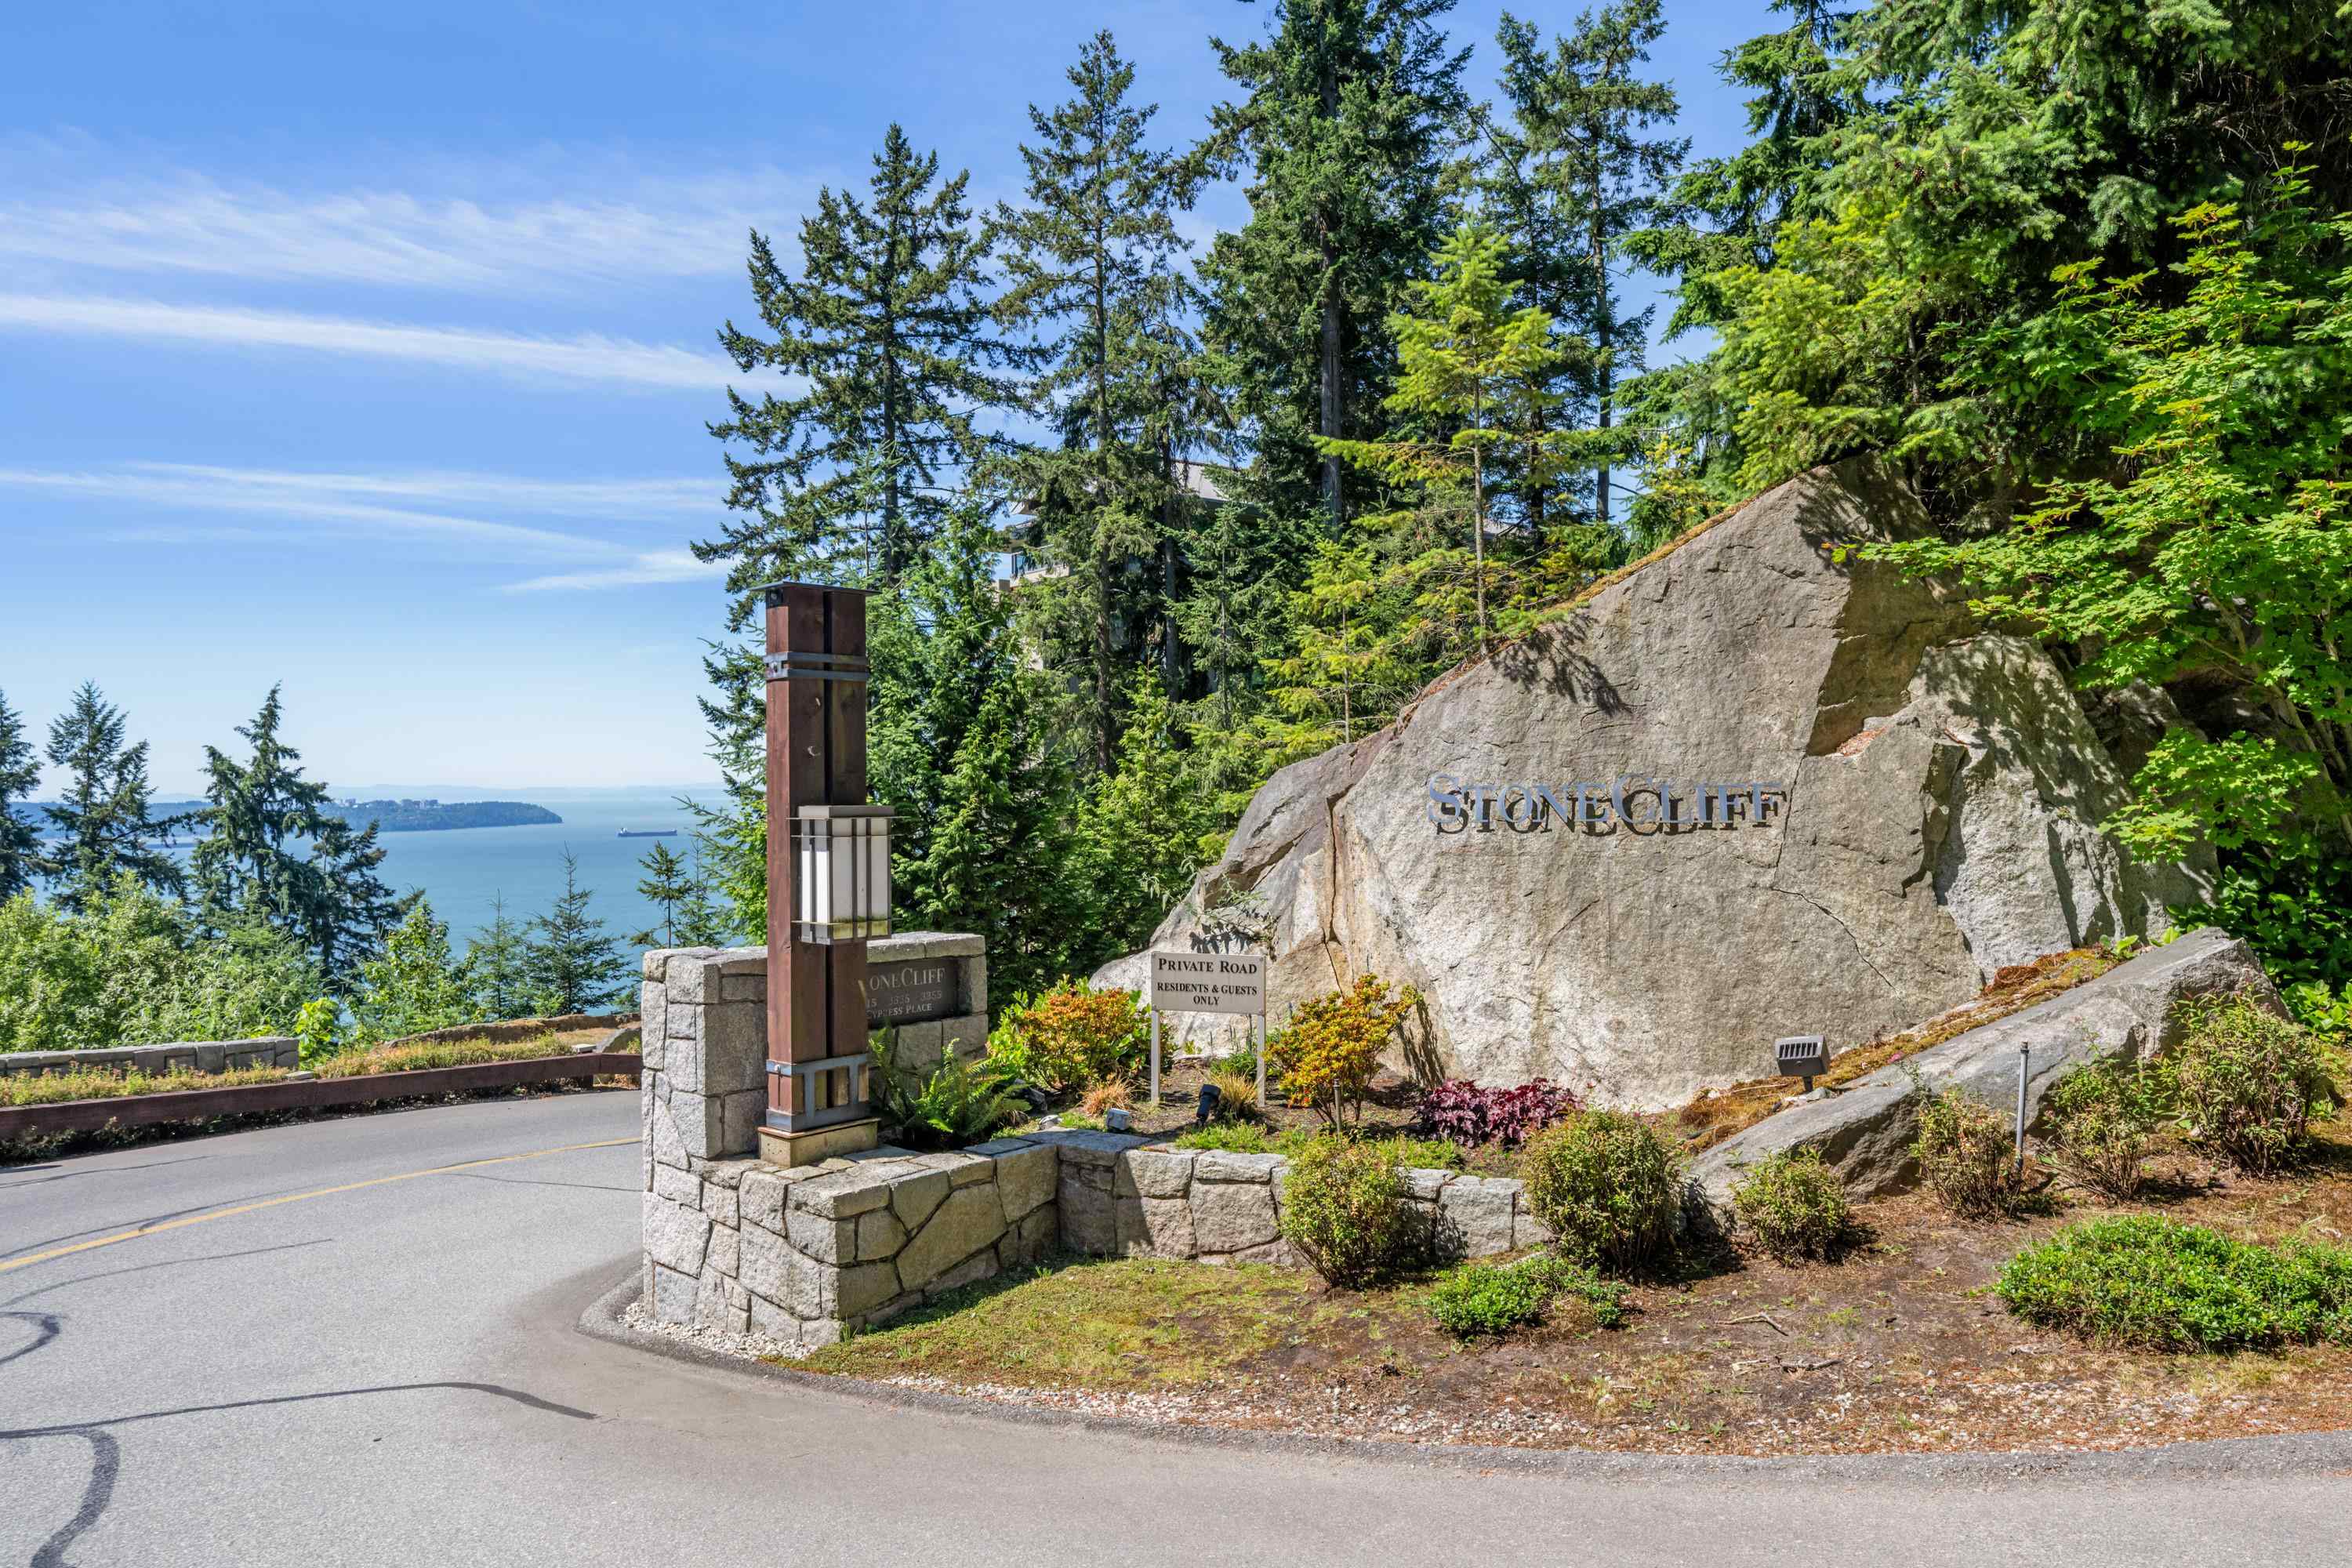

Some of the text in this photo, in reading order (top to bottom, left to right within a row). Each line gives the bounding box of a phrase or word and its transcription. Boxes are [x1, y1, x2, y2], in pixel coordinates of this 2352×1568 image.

[1428, 773, 1782, 823] STONECLIFF
[1158, 958, 1258, 975] PRIVATE ROAD
[869, 967, 946, 990] ONECLIFF
[1157, 982, 1258, 995] RESIDENTS & GUESTS
[1192, 995, 1220, 1006] ONLY
[906, 1003, 932, 1014] PLACE
